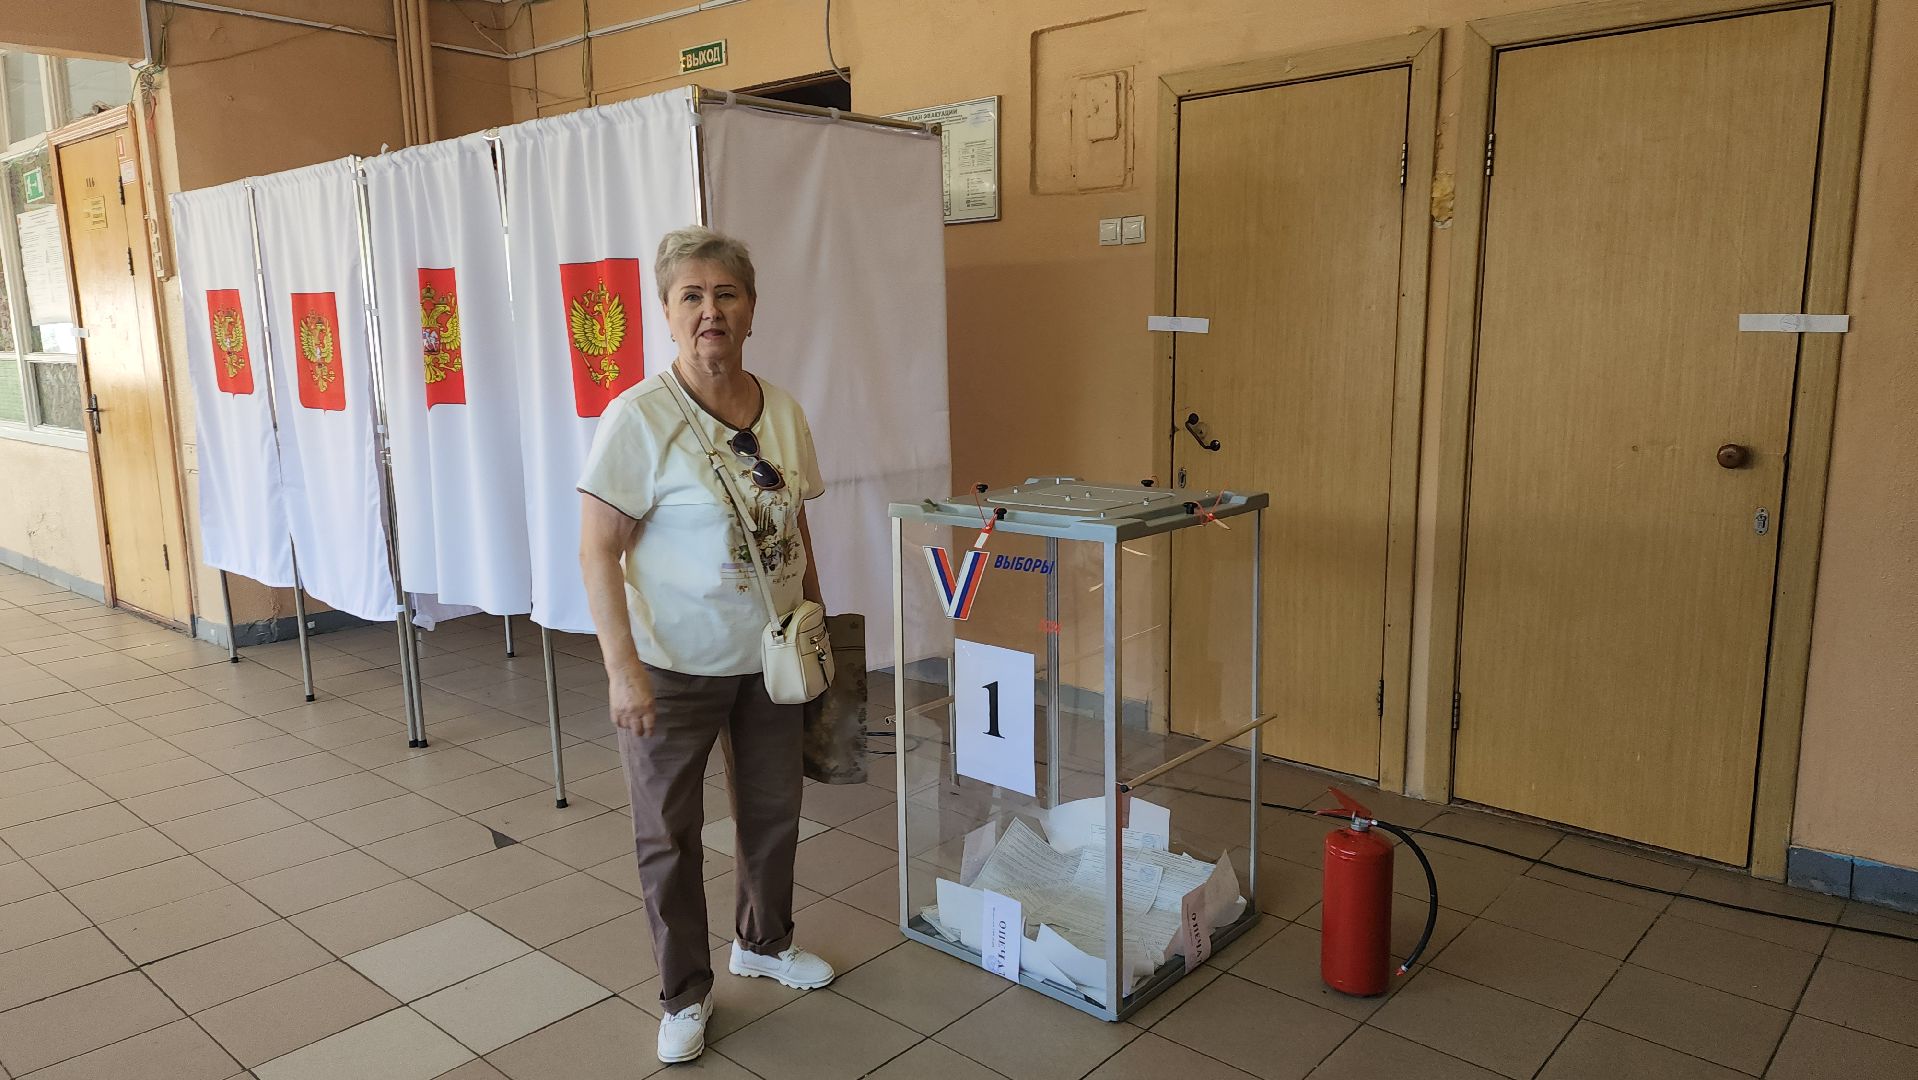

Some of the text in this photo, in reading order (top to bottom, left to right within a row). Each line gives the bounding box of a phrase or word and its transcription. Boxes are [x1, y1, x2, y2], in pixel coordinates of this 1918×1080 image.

[686, 46, 721, 69] ВЫХОД
[923, 108, 958, 119] ЭВАКУАЦИИ
[993, 554, 1055, 575] ВЫБОРЫ
[982, 680, 1006, 739] 1
